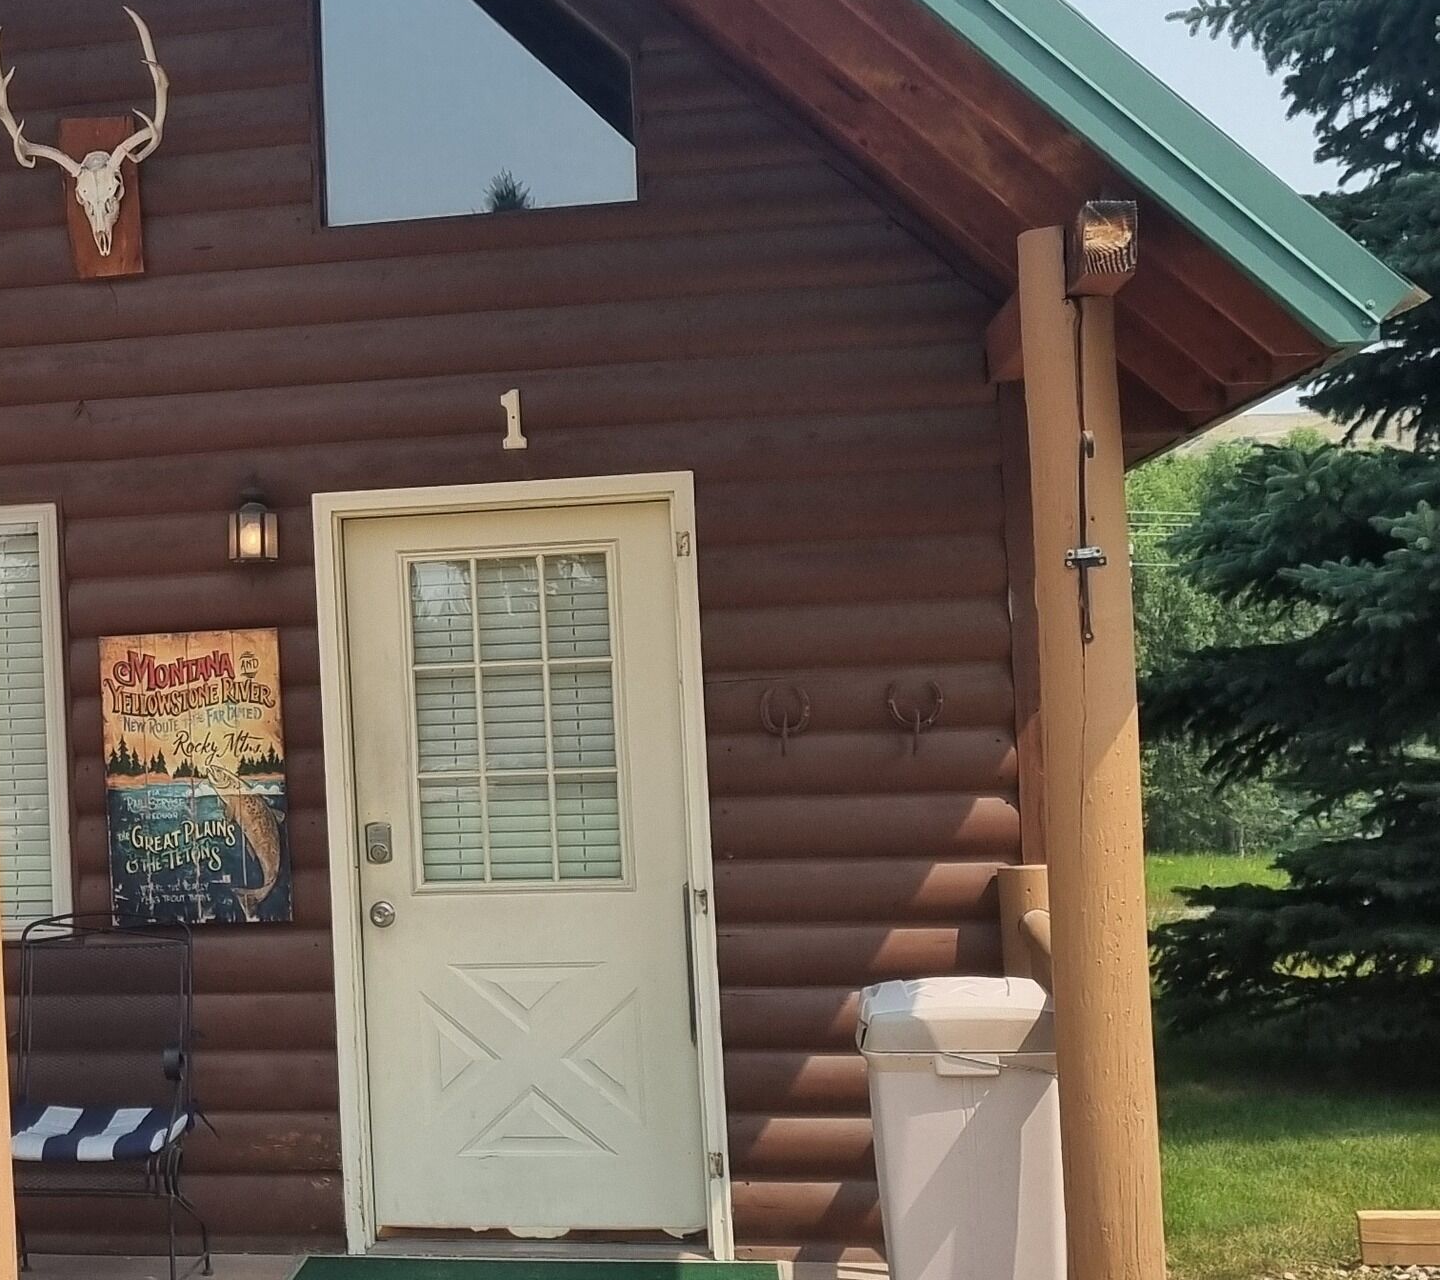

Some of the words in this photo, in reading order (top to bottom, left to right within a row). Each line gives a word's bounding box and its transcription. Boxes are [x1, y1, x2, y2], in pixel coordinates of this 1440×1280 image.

[500, 389, 527, 450] 1
[113, 650, 235, 691] MONTANA
[240, 656, 259, 673] AND
[104, 678, 219, 717] YELLOWSTONE
[220, 677, 276, 708] RIVER
[123, 716, 146, 733] NEW
[149, 718, 178, 739] ROUTE
[206, 708, 232, 728] FAR
[173, 730, 218, 765] Rocky
[131, 825, 181, 853] GREAT
[180, 819, 236, 846] PLAINS
[142, 855, 163, 872] THE
[161, 843, 222, 871] TETONS
